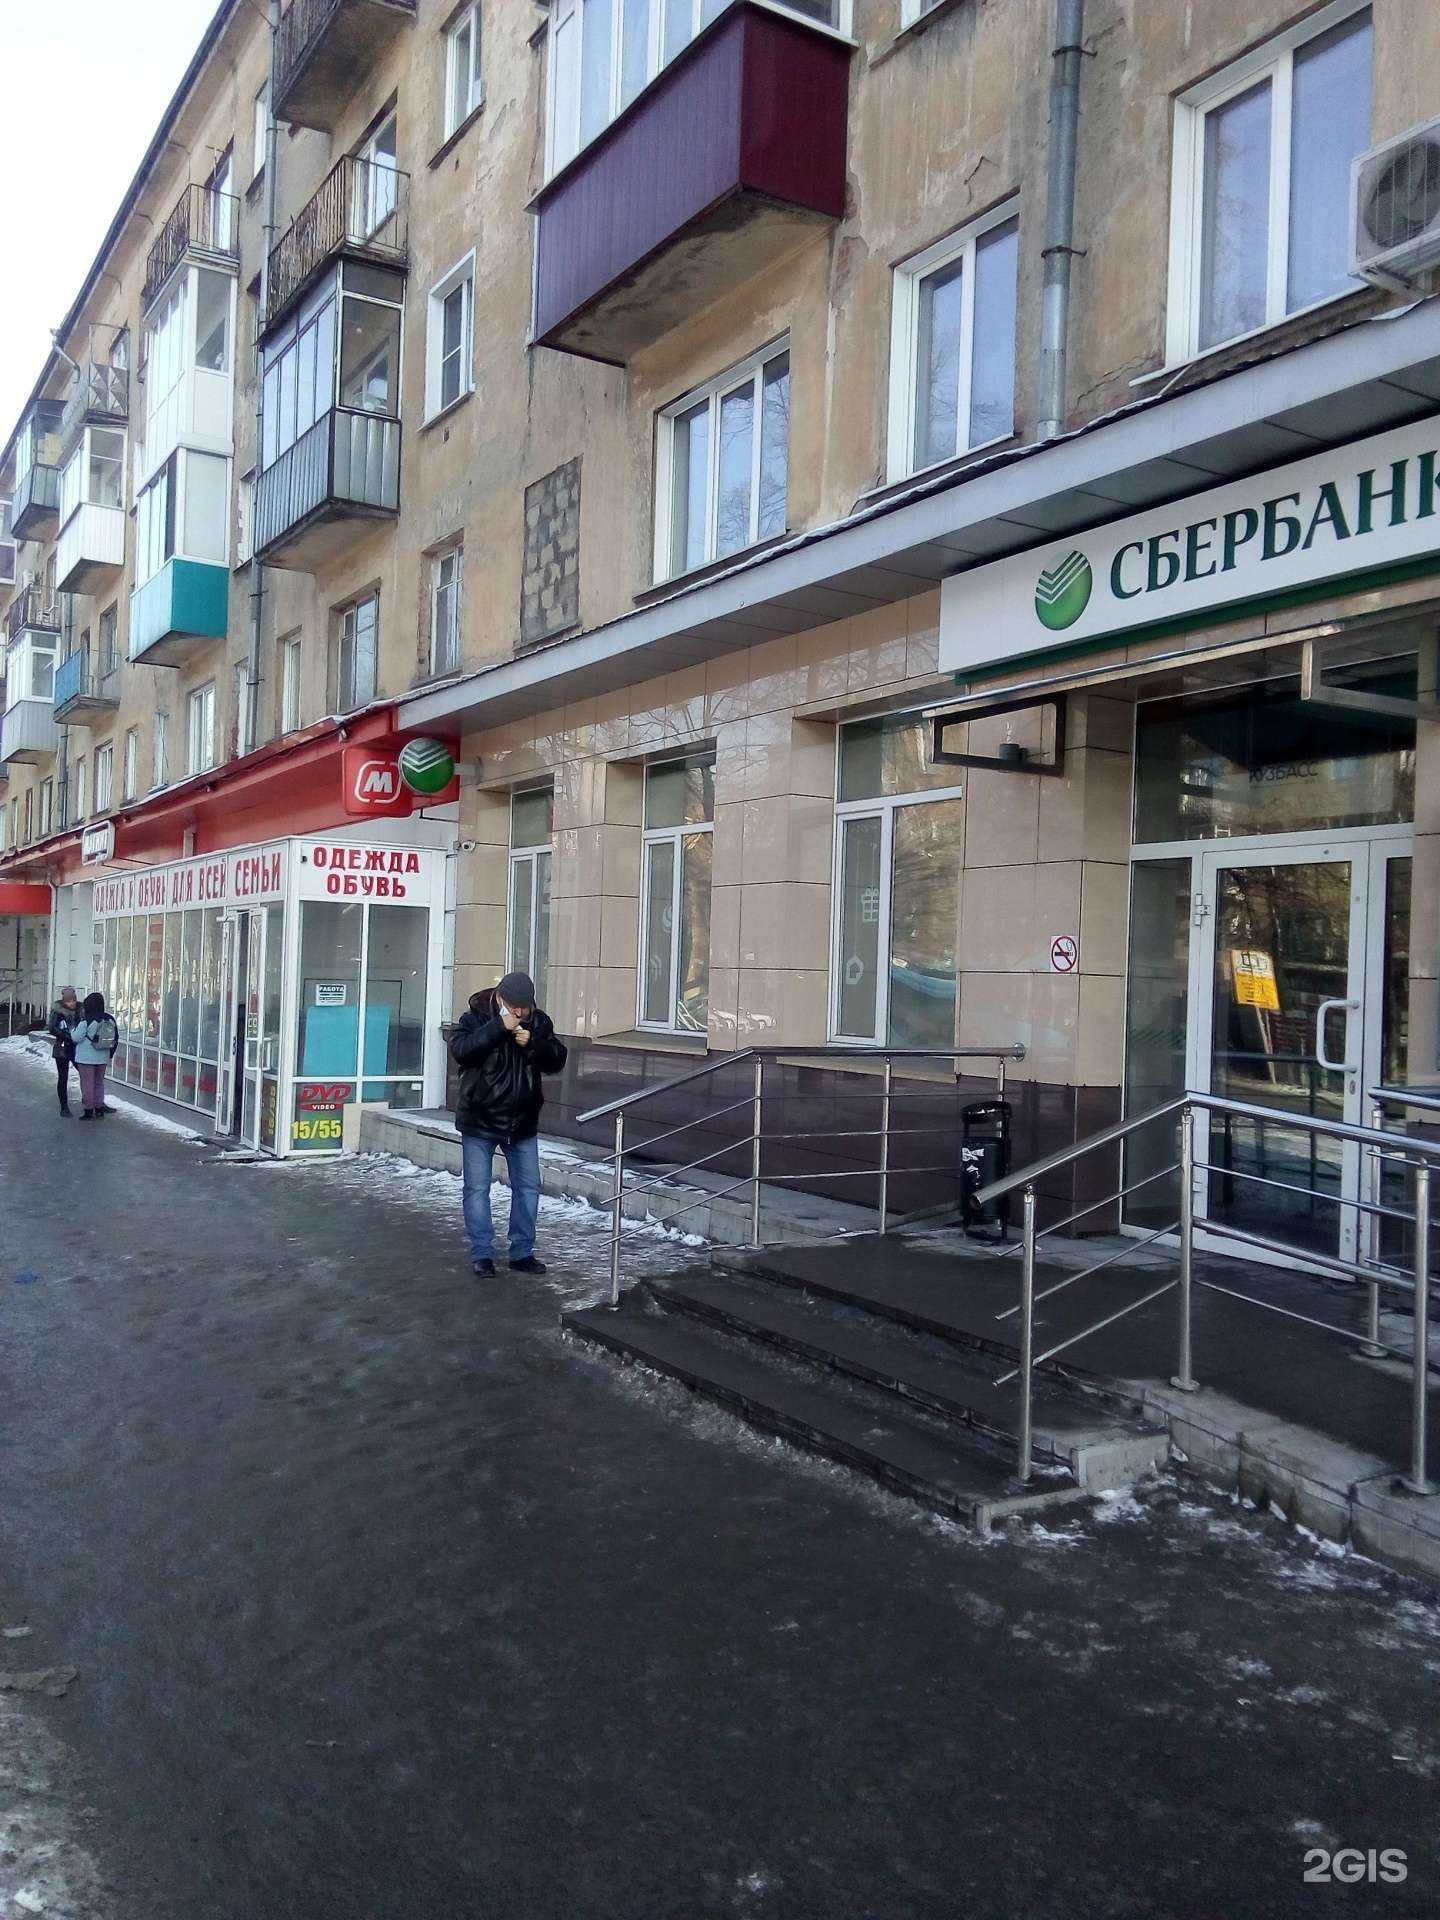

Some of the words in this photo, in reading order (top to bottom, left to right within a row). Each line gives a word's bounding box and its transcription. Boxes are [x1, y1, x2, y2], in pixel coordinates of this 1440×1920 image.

[313, 846, 420, 874] ОДЕЖДА
[235, 852, 281, 897] СЕМЬИ
[327, 873, 406, 898] ОБУВЬ
[301, 1084, 352, 1101] DVD
[291, 1120, 342, 1139] 15/55
